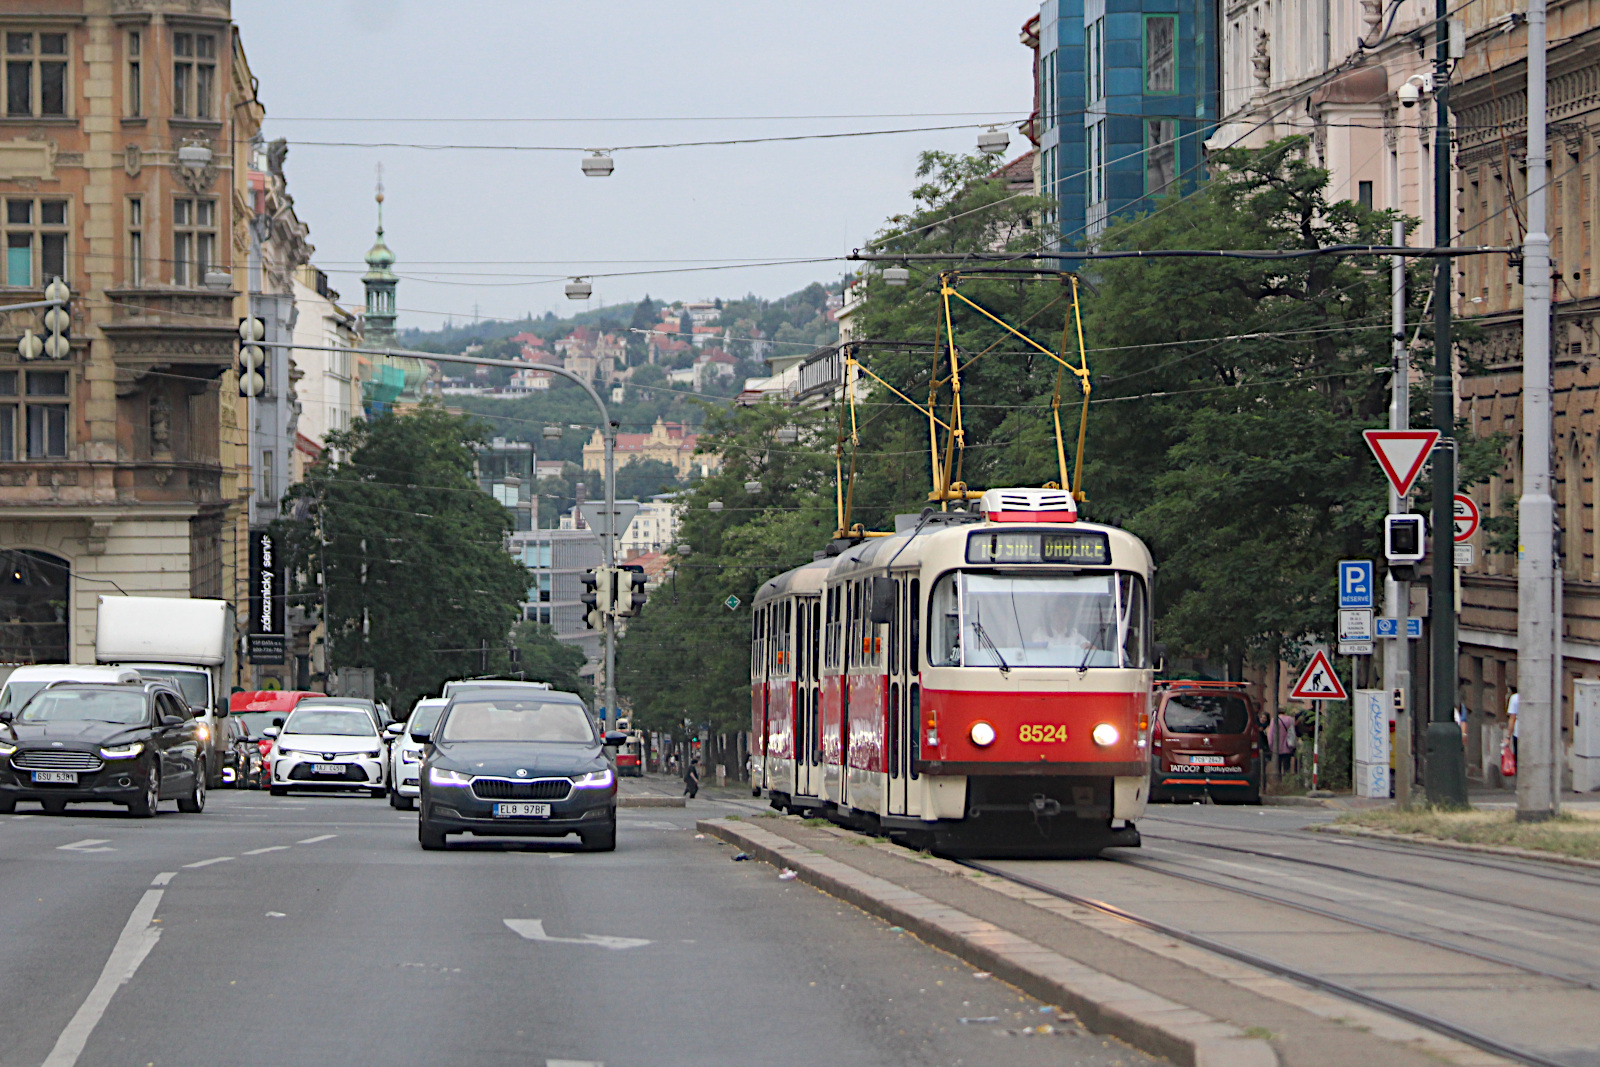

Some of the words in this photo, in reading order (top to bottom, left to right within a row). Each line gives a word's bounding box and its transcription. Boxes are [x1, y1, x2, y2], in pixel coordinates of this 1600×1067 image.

[260, 534, 272, 568] servis
[1346, 567, 1365, 593] P
[260, 569, 274, 632] zákaznický
[1019, 724, 1068, 742] 8524
[37, 772, 52, 781] 6SU
[1170, 764, 1200, 773] TATTOO?
[500, 804, 517, 814] EL8
[523, 804, 546, 815] 97BF
